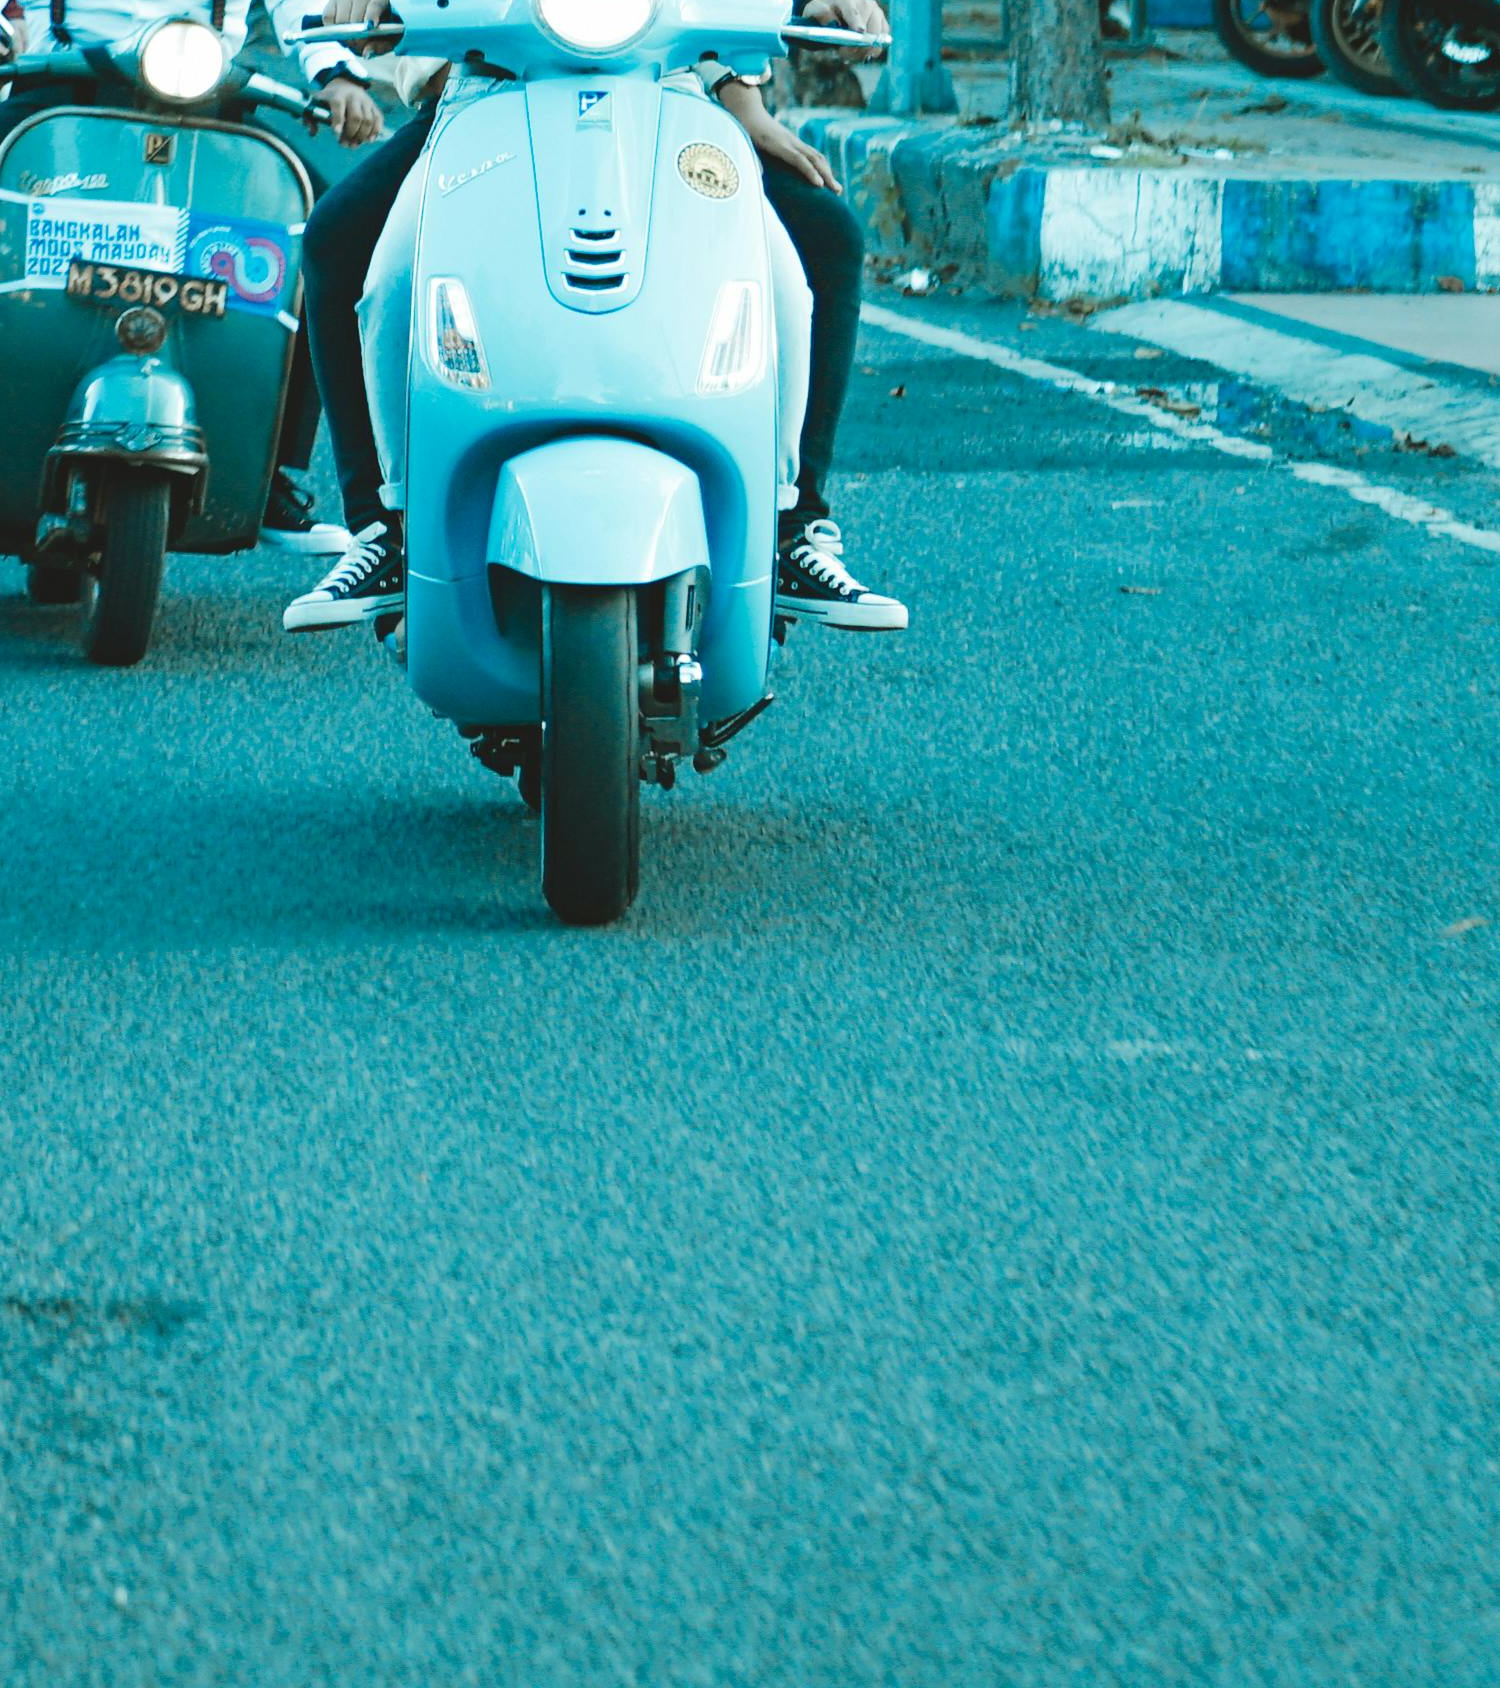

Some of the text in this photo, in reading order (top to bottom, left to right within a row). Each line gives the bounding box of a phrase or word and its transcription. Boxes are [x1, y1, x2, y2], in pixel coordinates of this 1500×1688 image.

[30, 219, 140, 242] BANGKALAN
[29, 238, 172, 263] MODS MAYDAY
